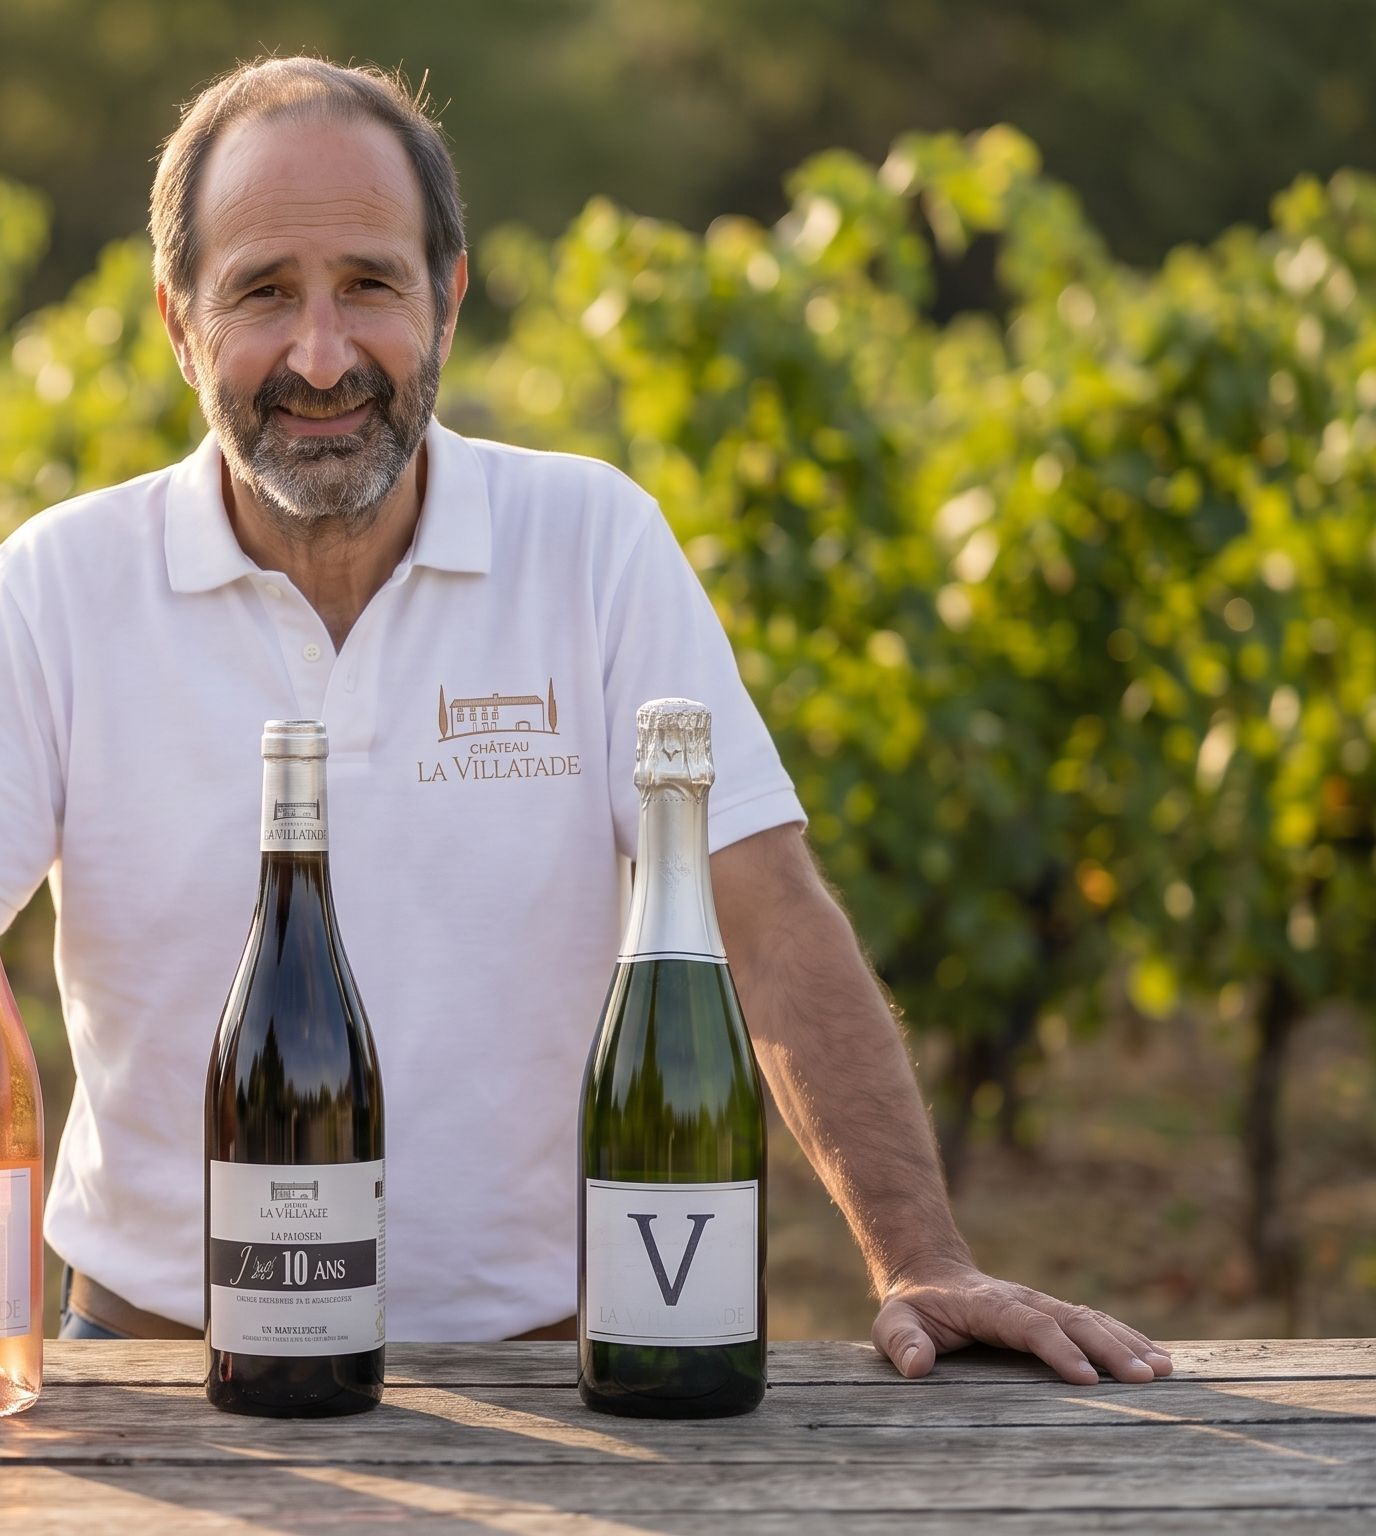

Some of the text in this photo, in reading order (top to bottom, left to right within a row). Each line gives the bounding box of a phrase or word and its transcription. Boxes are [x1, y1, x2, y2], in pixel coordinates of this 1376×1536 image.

[470, 740, 529, 754] CHÂTEAU
[417, 755, 582, 783] LA VILLATADE
[260, 1207, 274, 1219] LA
[282, 1250, 308, 1286] 10
[313, 1259, 346, 1281] ANS
[627, 1213, 716, 1307] V
[599, 1306, 619, 1325] LA
